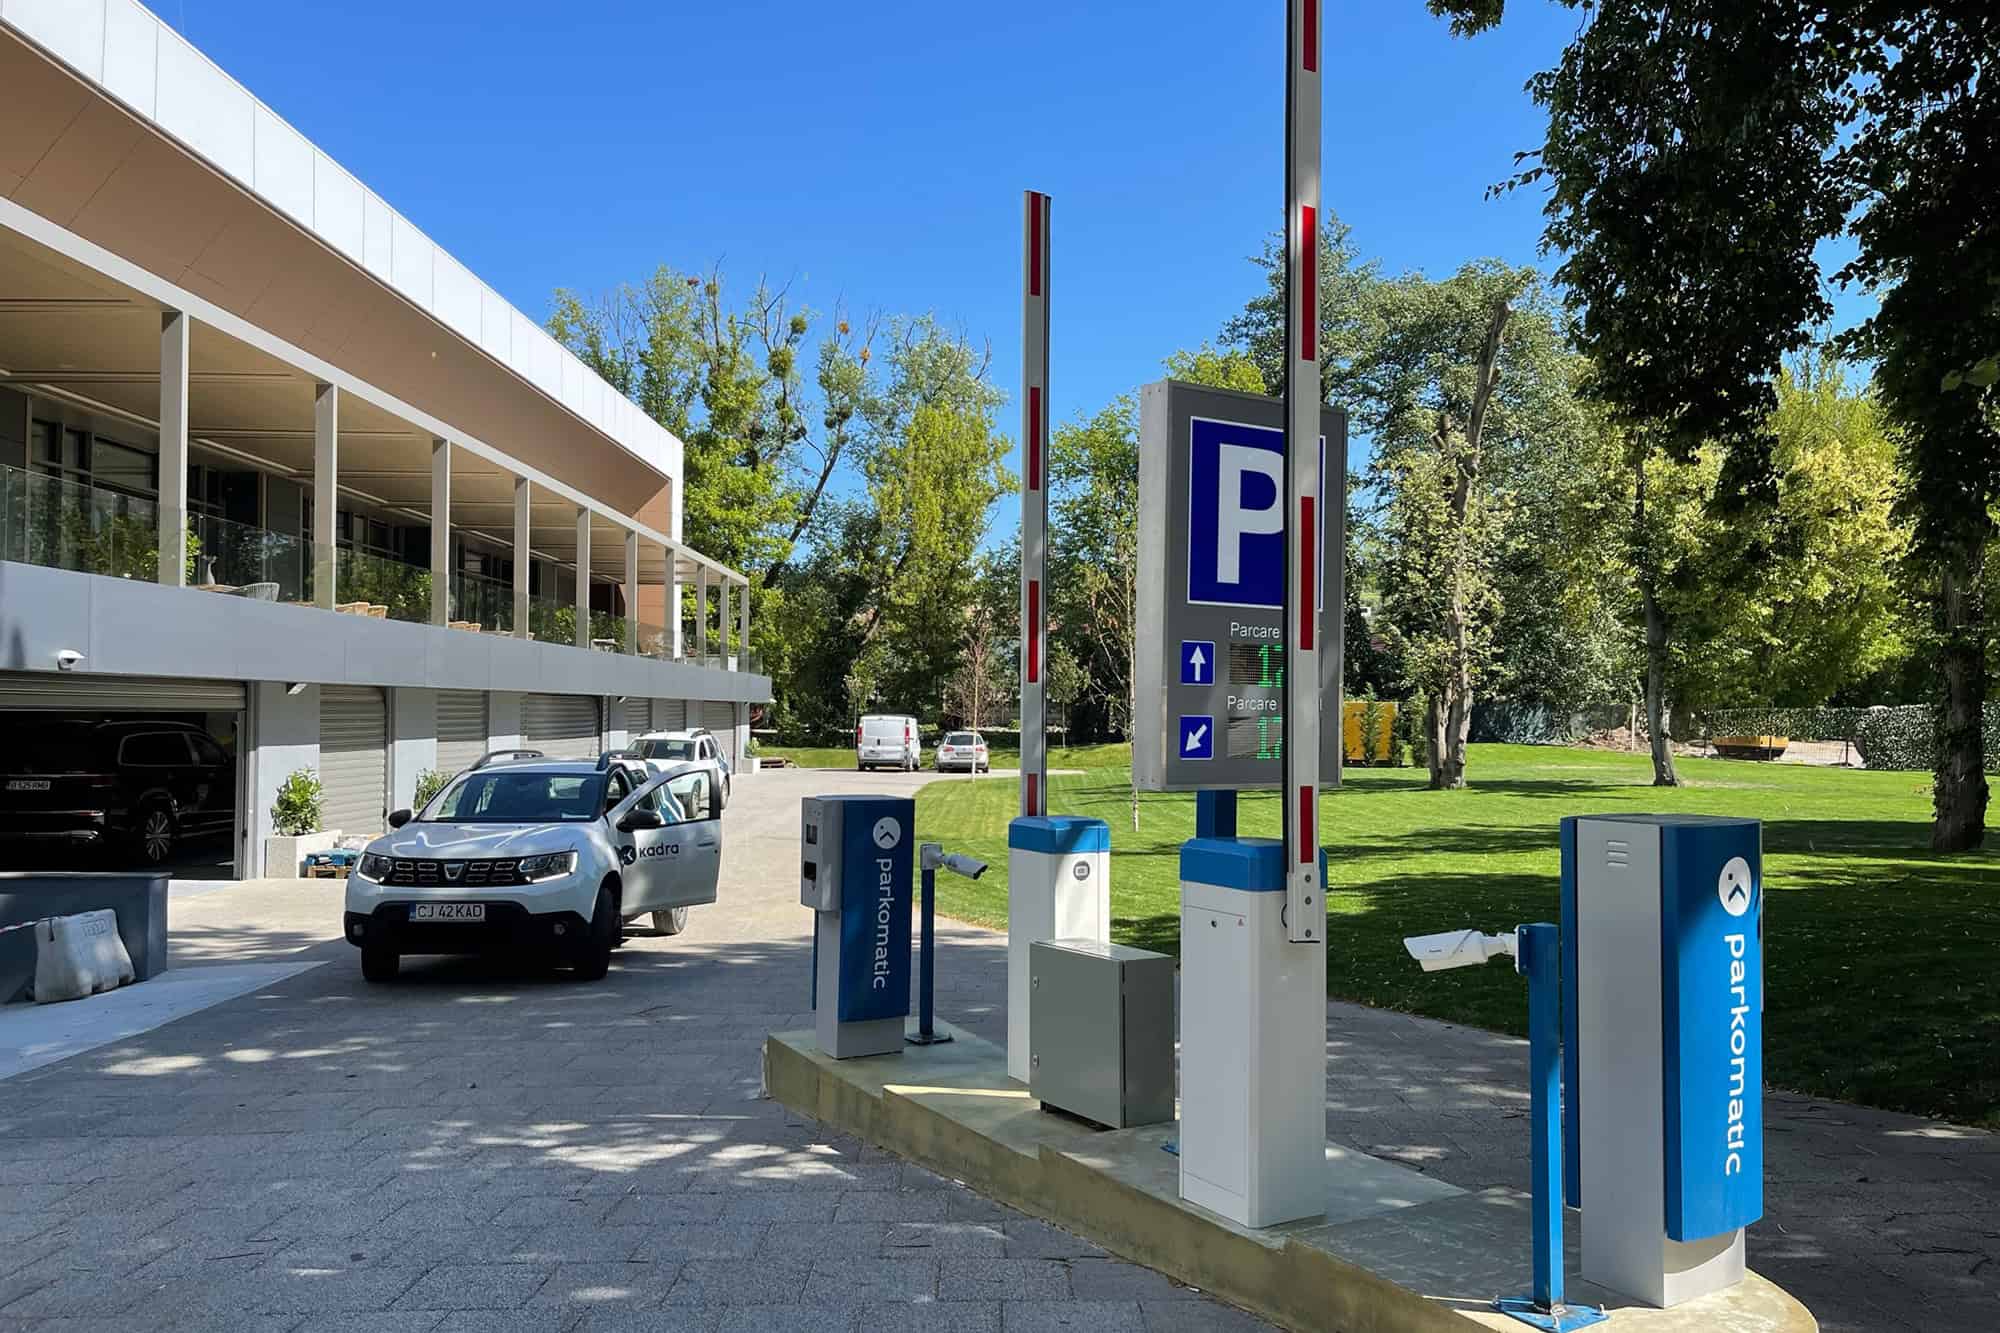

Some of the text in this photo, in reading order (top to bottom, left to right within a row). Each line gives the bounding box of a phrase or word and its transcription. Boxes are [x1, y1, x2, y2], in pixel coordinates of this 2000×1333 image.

[1230, 622, 1281, 639] Parcare
[1227, 695, 1278, 711] Parcare
[639, 842, 680, 858] kadra
[417, 905, 434, 918] CJ
[873, 858, 895, 989] parkomatic
[1724, 933, 1750, 1176] parkomatic
